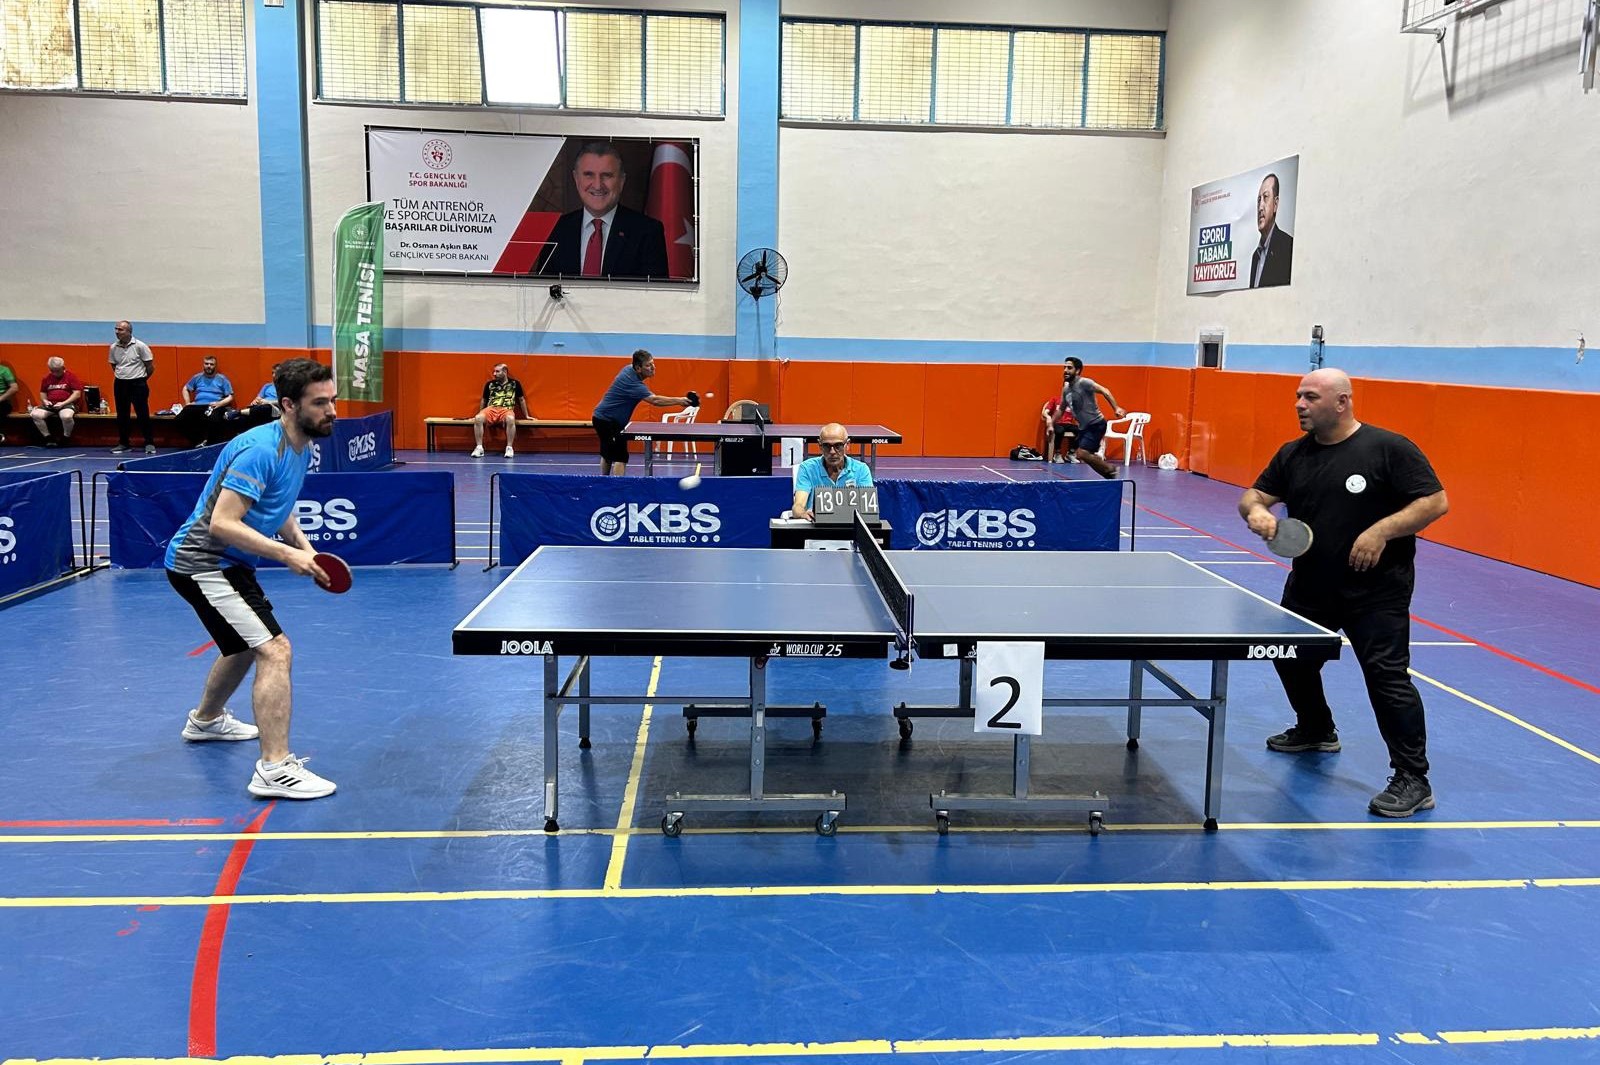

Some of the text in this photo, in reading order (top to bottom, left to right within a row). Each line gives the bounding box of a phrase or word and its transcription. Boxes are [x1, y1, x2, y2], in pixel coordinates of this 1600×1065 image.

[424, 172, 456, 180] GENÇLİK
[429, 181, 468, 189] BAKANLIĞI
[392, 197, 484, 212] TÜM ANTRENÖR
[397, 210, 497, 223] SPORCULARIMIZA
[385, 222, 493, 234] BAŞARILAR DİLİYORUM
[1201, 226, 1227, 244] SPORU
[440, 243, 461, 251] Aşkın
[1200, 243, 1229, 264] TABANA
[435, 252, 457, 260] SPOR
[458, 253, 489, 261] BAKANI
[1195, 262, 1236, 280] YAYIYORUZ
[356, 262, 376, 326] TENİSİ
[352, 330, 371, 389] MASA
[356, 431, 376, 454] KBS
[816, 490, 878, 512] 13 0 2 14
[293, 498, 358, 531] BS
[628, 502, 722, 533] KBS
[947, 508, 1037, 539] KBS
[629, 535, 687, 543] TABLE TENNIS
[947, 540, 1003, 549] TABLE TENNIS
[500, 640, 554, 655] JOOLA
[786, 643, 844, 657] WORLD CUP 25
[1247, 645, 1298, 659] JOOLA
[987, 675, 1022, 729] 2
